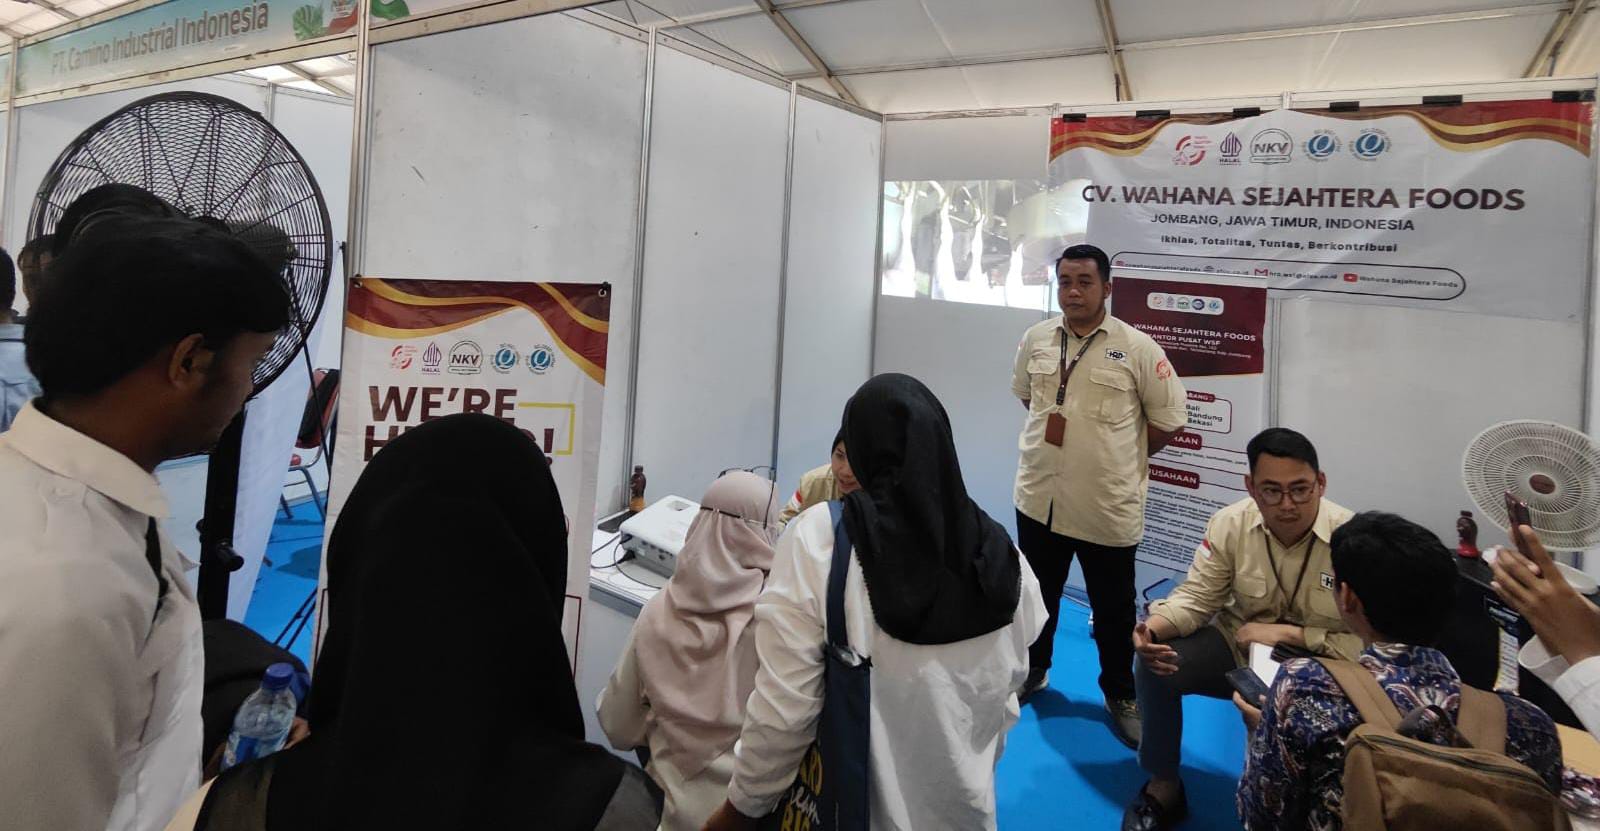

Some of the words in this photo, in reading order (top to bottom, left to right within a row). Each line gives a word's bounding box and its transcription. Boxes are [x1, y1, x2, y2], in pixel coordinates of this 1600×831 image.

[51, 51, 67, 74] PT.
[67, 43, 110, 70] Camino
[111, 18, 179, 61] Industrial
[181, 1, 269, 47] Indonesia
[1253, 142, 1289, 154] NKV
[1082, 185, 1117, 203] CV.
[1122, 186, 1235, 206] WAHANA
[1241, 187, 1400, 209] SEJAHTERA
[1408, 188, 1526, 211] FOODS
[1151, 213, 1222, 227] JOMBANG,
[1225, 216, 1267, 228] JAWA
[1271, 216, 1321, 230] TIMUR,
[1325, 217, 1415, 231] INDONESIA
[1201, 237, 1256, 248] Totalitas,
[1259, 239, 1304, 250] Tuntas,
[1308, 241, 1398, 252] Berkontribusi
[1391, 278, 1430, 287] Sejahtera
[1432, 280, 1458, 288] Foods
[1132, 323, 1170, 332] WAHANA
[1172, 326, 1222, 338] SEJAHTERA
[1223, 332, 1256, 342] FOODS
[1178, 336, 1202, 344] PUSAT
[452, 354, 480, 364] NKV
[1187, 411, 1223, 422] Bandung
[1187, 417, 1213, 426] Bekasi
